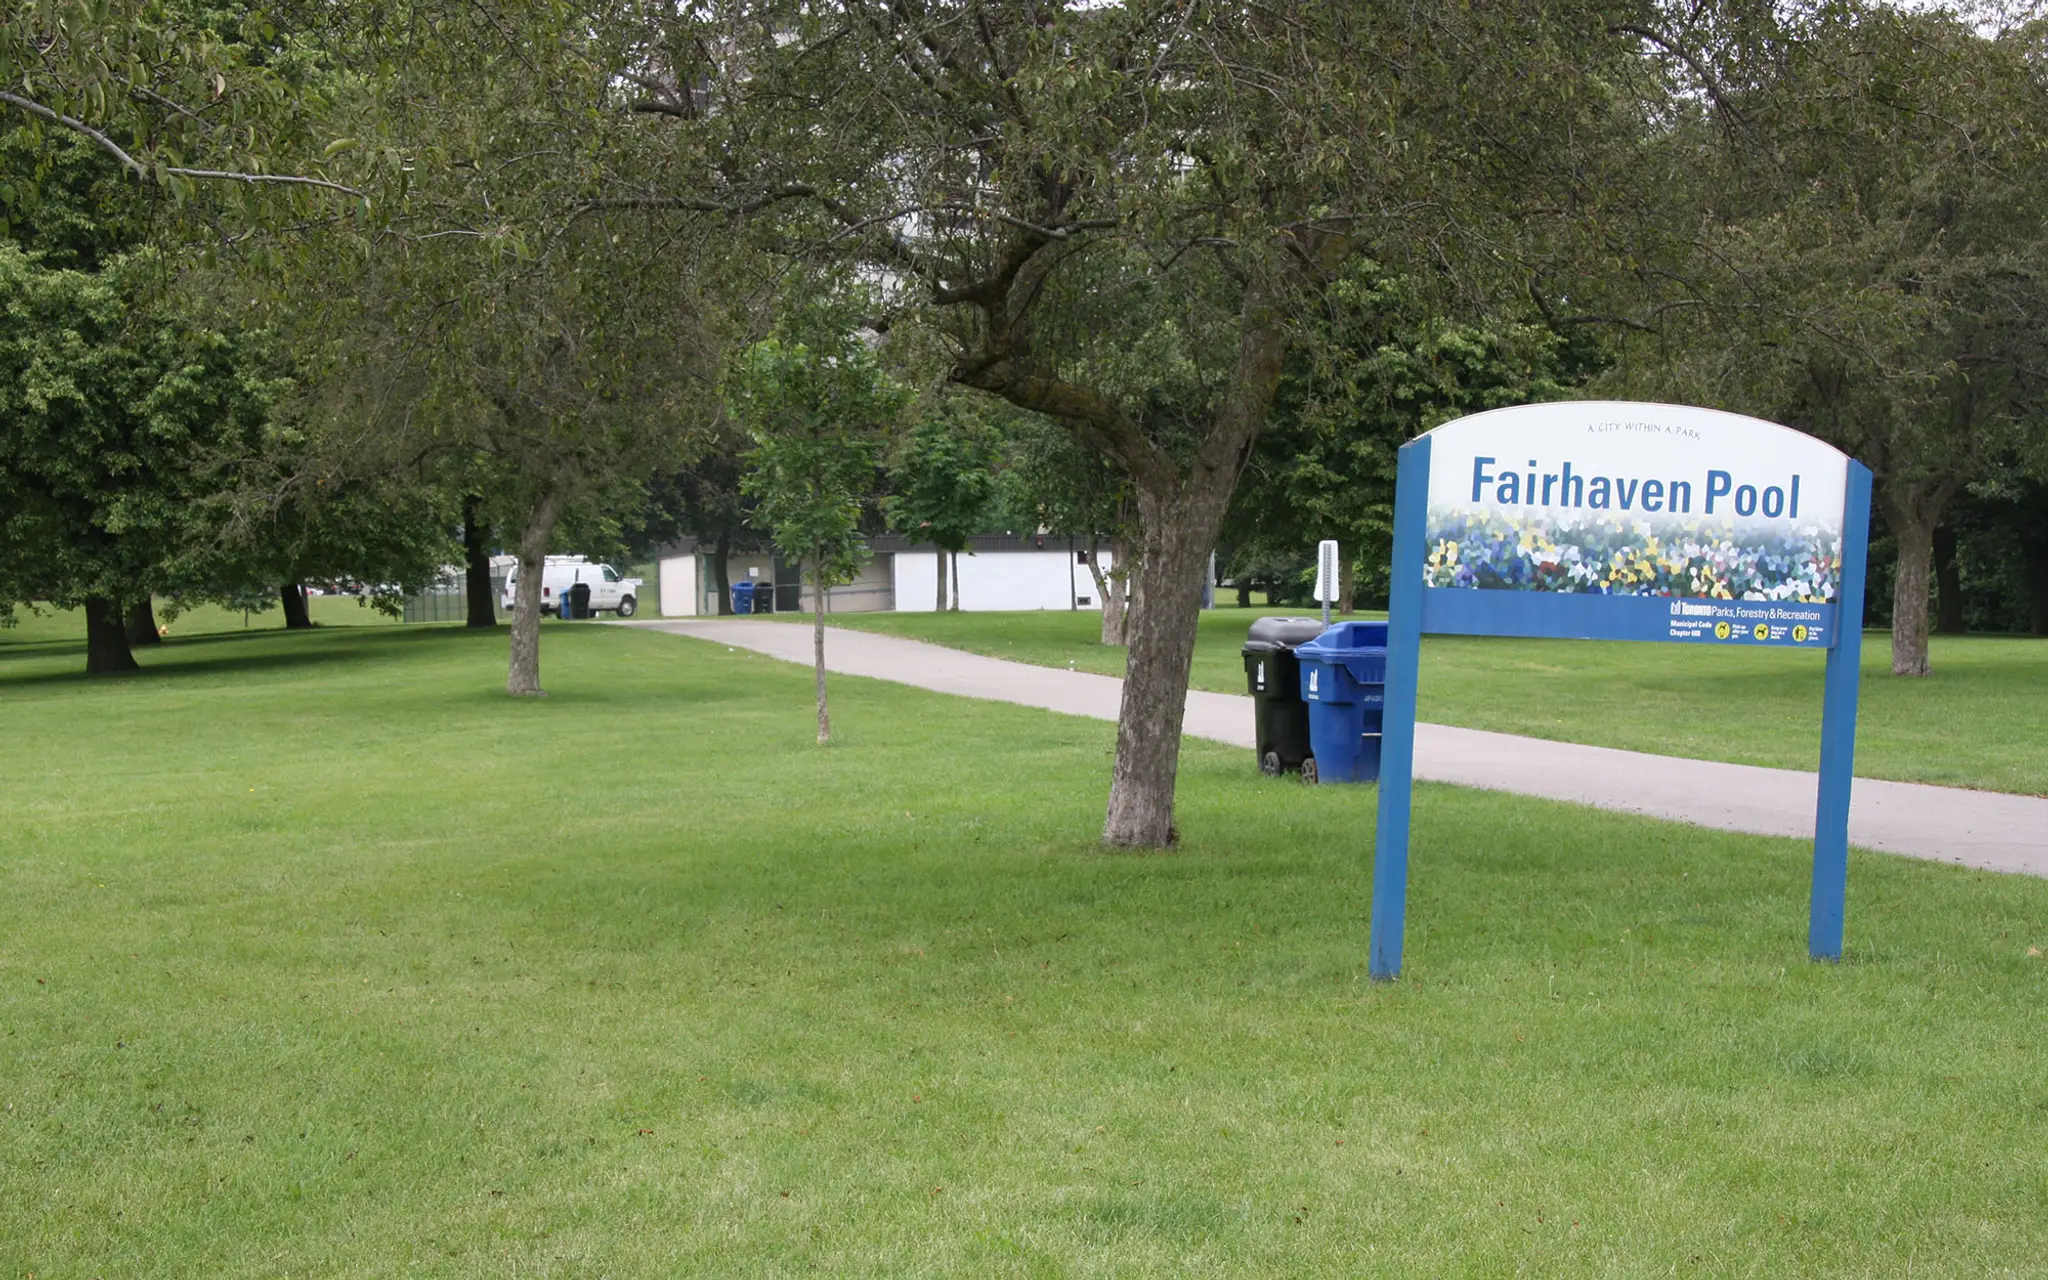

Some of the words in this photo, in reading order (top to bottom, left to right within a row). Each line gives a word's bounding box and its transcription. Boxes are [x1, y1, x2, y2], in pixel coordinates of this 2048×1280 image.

[1587, 424, 1595, 433] A
[1598, 422, 1621, 432] CITY
[1625, 422, 1661, 432] WITHIN
[1665, 426, 1672, 434] A
[1676, 426, 1701, 441] PARK
[1471, 456, 1692, 514] Fairhaven
[1704, 469, 1801, 519] Pool
[1711, 605, 1735, 618] Parks,
[1736, 606, 1769, 620] Forestry
[1769, 608, 1776, 619] &
[1776, 607, 1820, 620] Recreation
